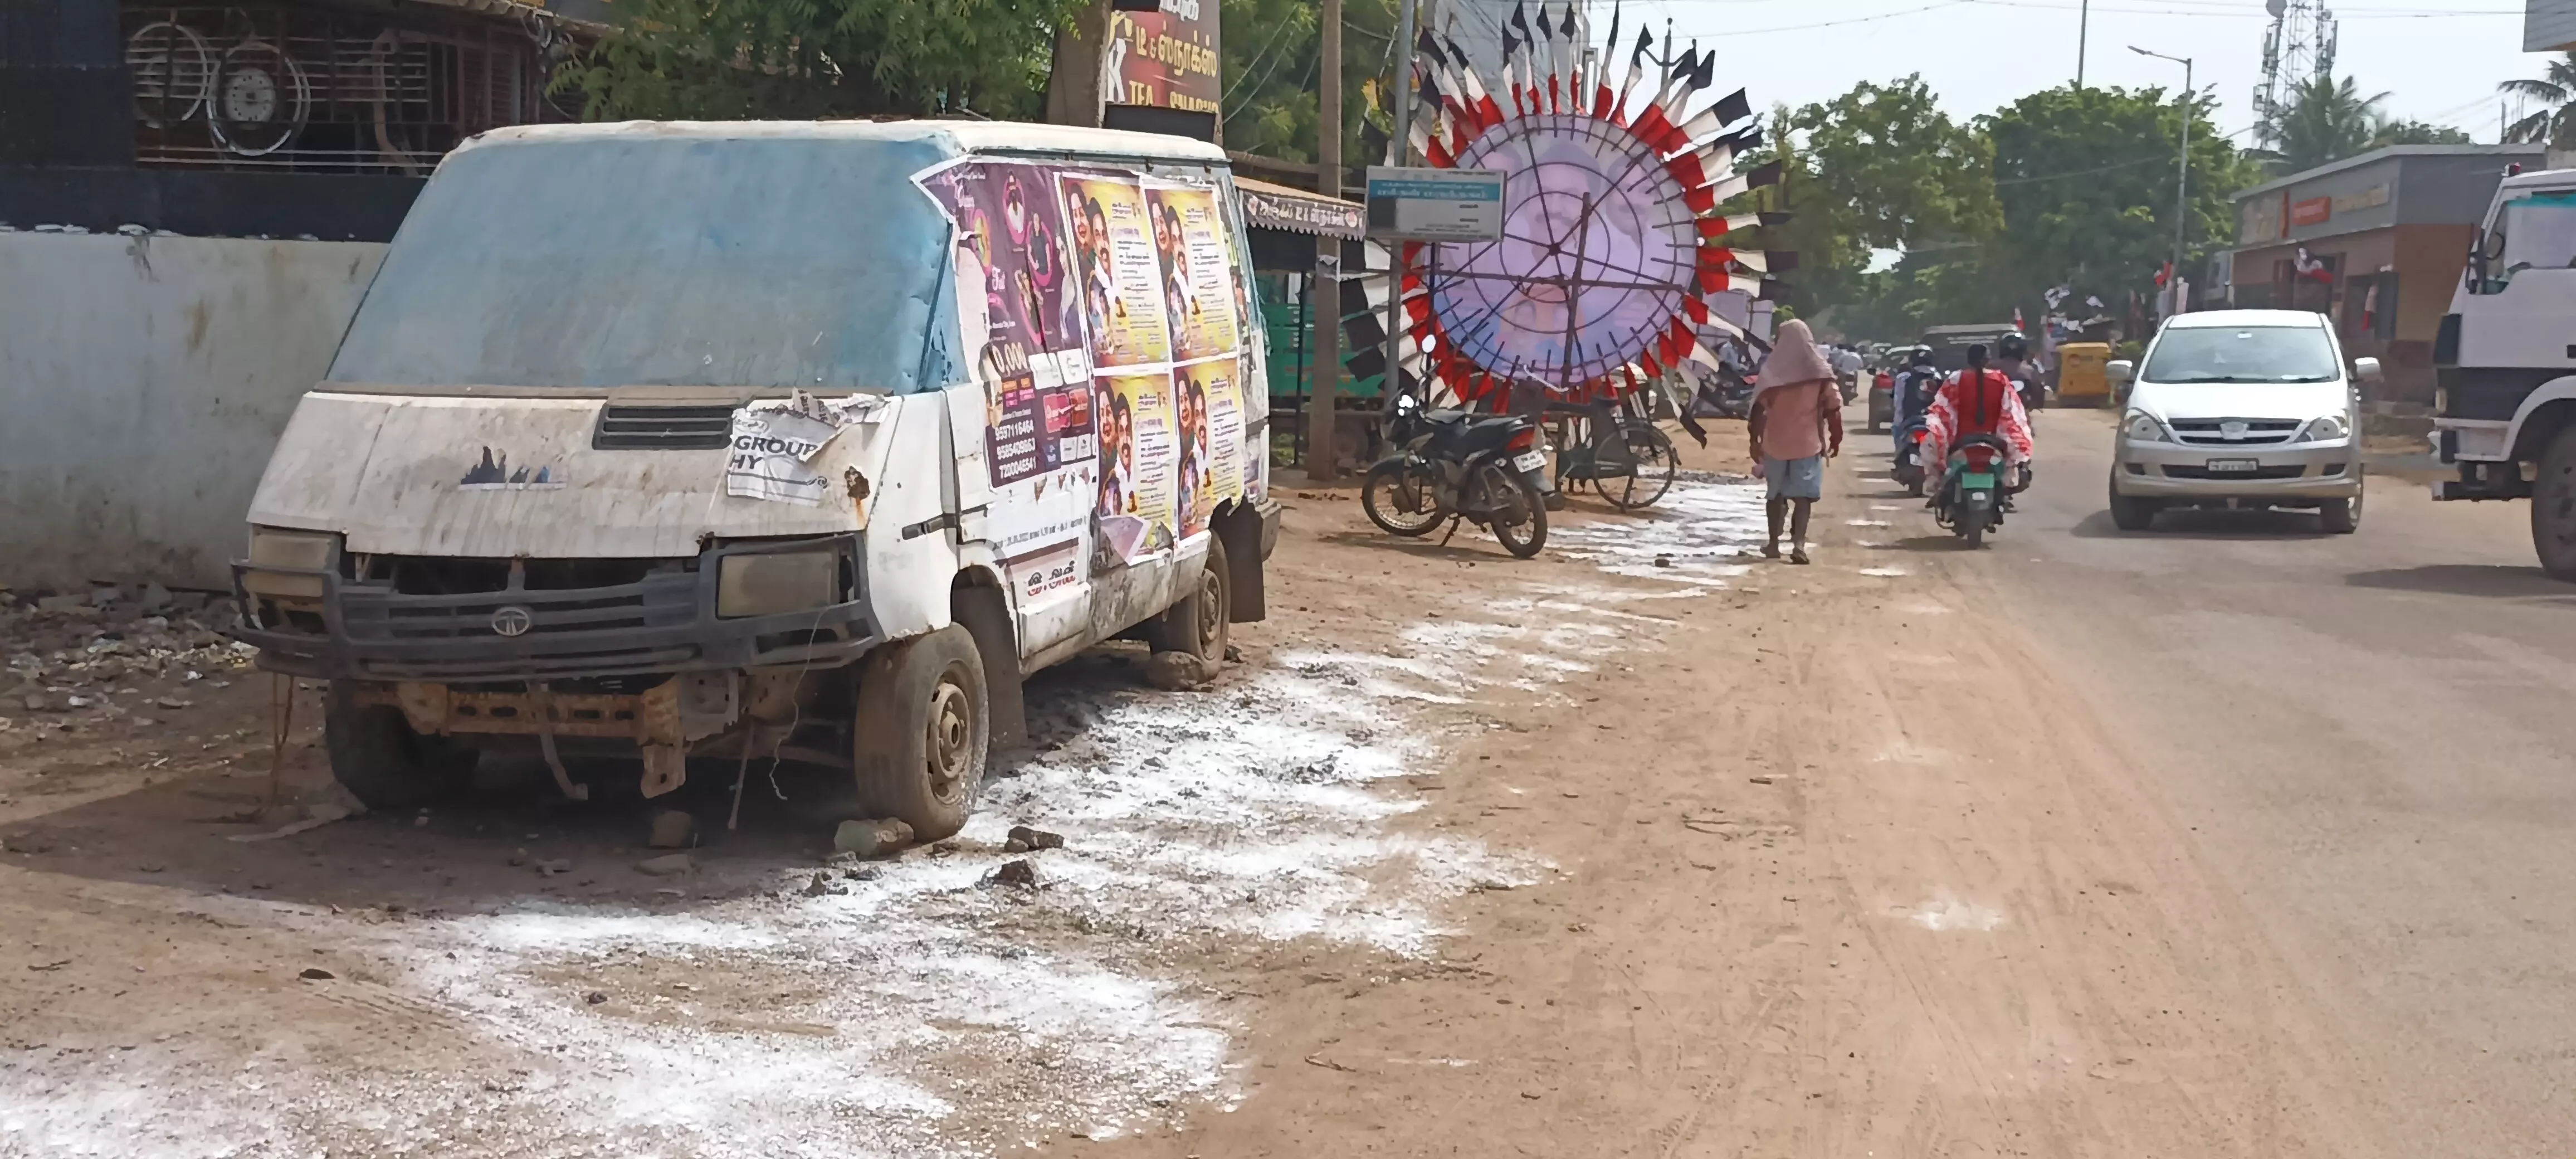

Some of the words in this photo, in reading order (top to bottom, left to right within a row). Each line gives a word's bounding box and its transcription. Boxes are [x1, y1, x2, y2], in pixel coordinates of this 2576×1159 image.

[1158, 20, 1217, 77] ஸ்நாக்ஸ்
[1129, 80, 1154, 105] TEA
[735, 435, 818, 456] GROUP
